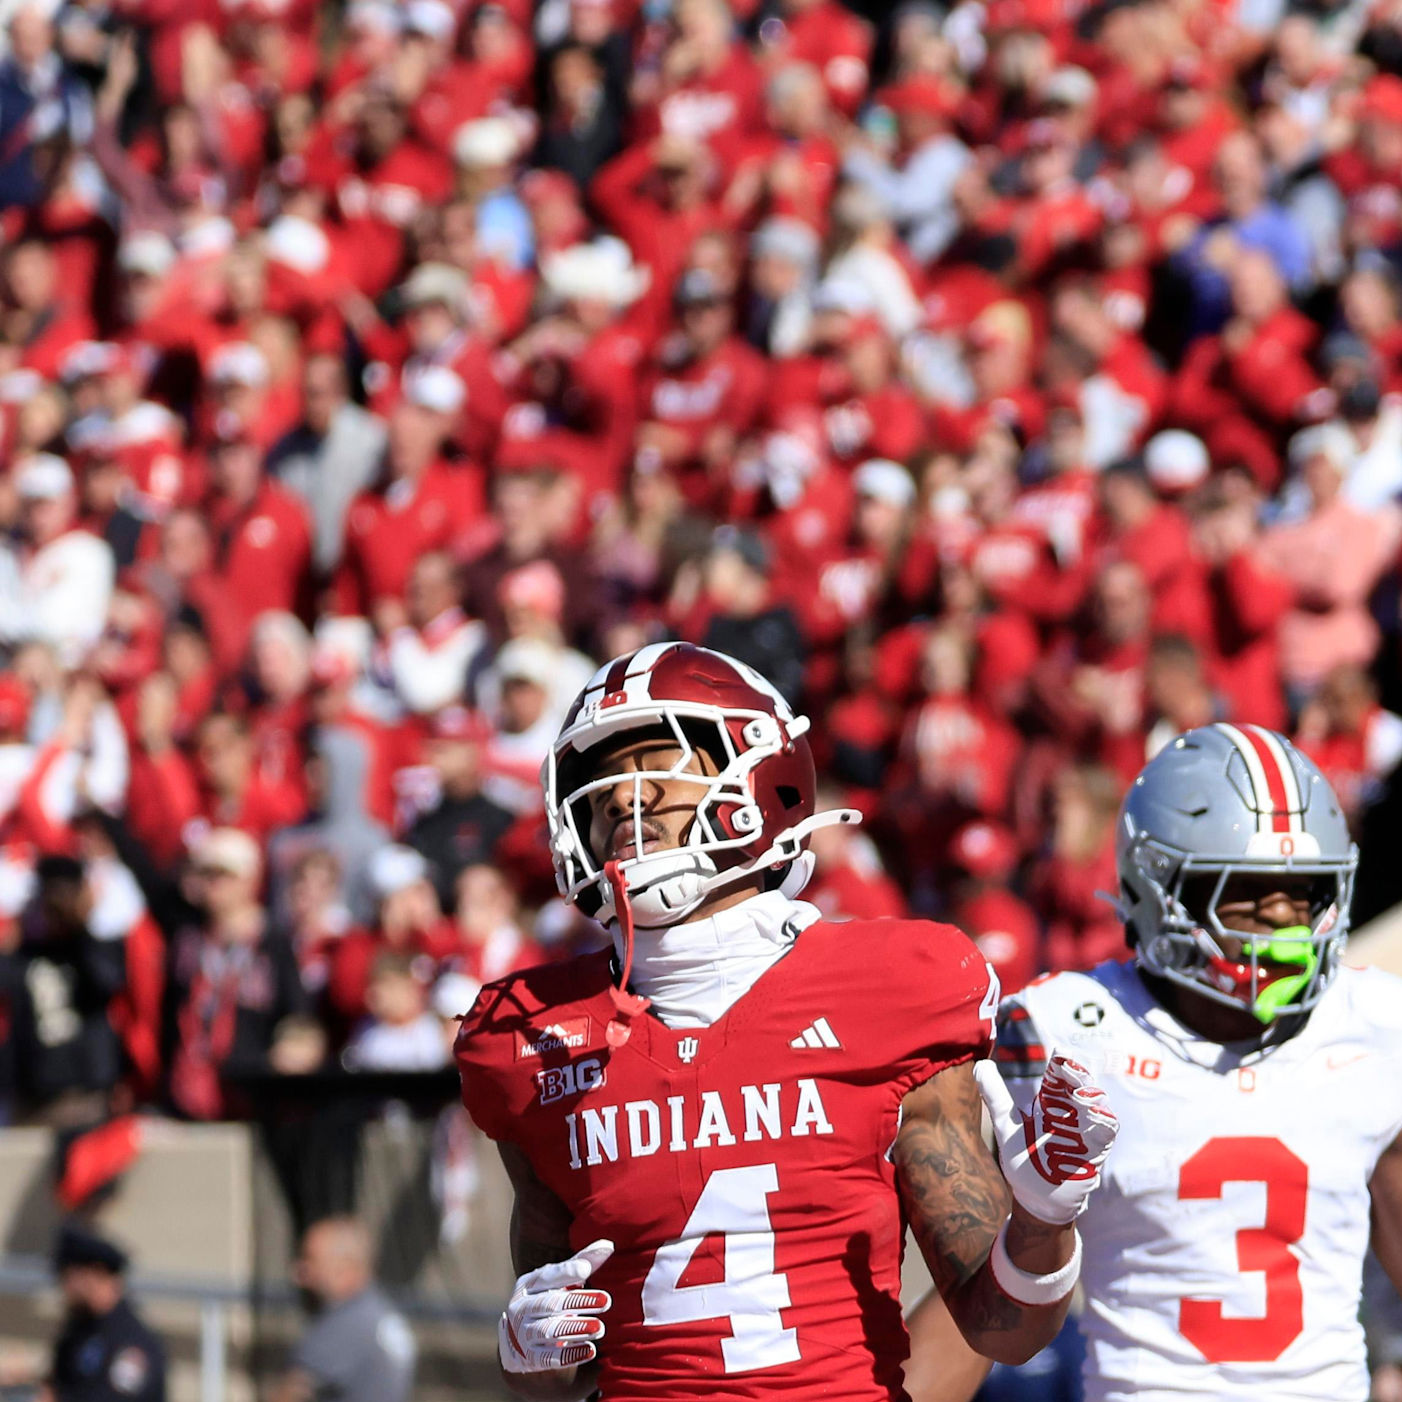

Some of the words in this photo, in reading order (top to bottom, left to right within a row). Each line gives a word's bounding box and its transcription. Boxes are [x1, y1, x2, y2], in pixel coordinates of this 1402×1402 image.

[520, 1032, 584, 1058] MERCHANTS
[978, 963, 1000, 1040] 4
[565, 1078, 834, 1170] INDIANA
[640, 1162, 802, 1374] 4
[1177, 1136, 1309, 1363] 3
